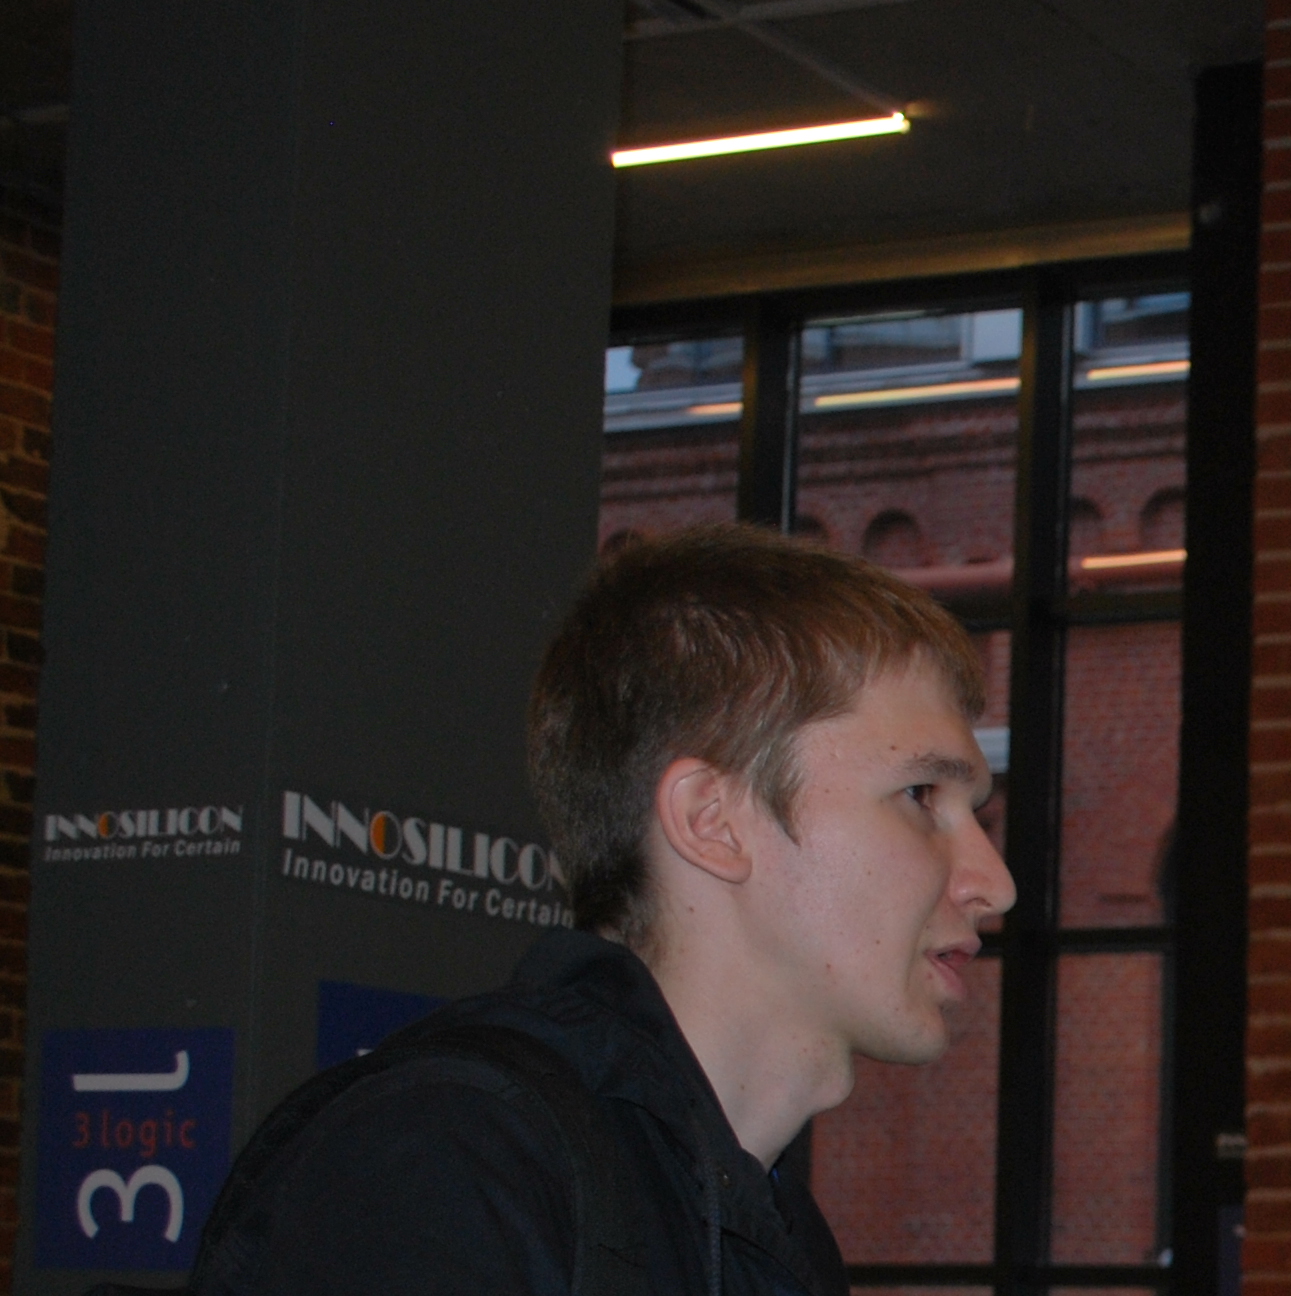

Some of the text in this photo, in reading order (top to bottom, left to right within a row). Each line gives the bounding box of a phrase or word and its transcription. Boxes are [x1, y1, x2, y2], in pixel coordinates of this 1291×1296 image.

[45, 806, 243, 841] INNOSILICON
[45, 837, 241, 862] Innovation For Certain
[283, 848, 574, 929] Innovation For Certain
